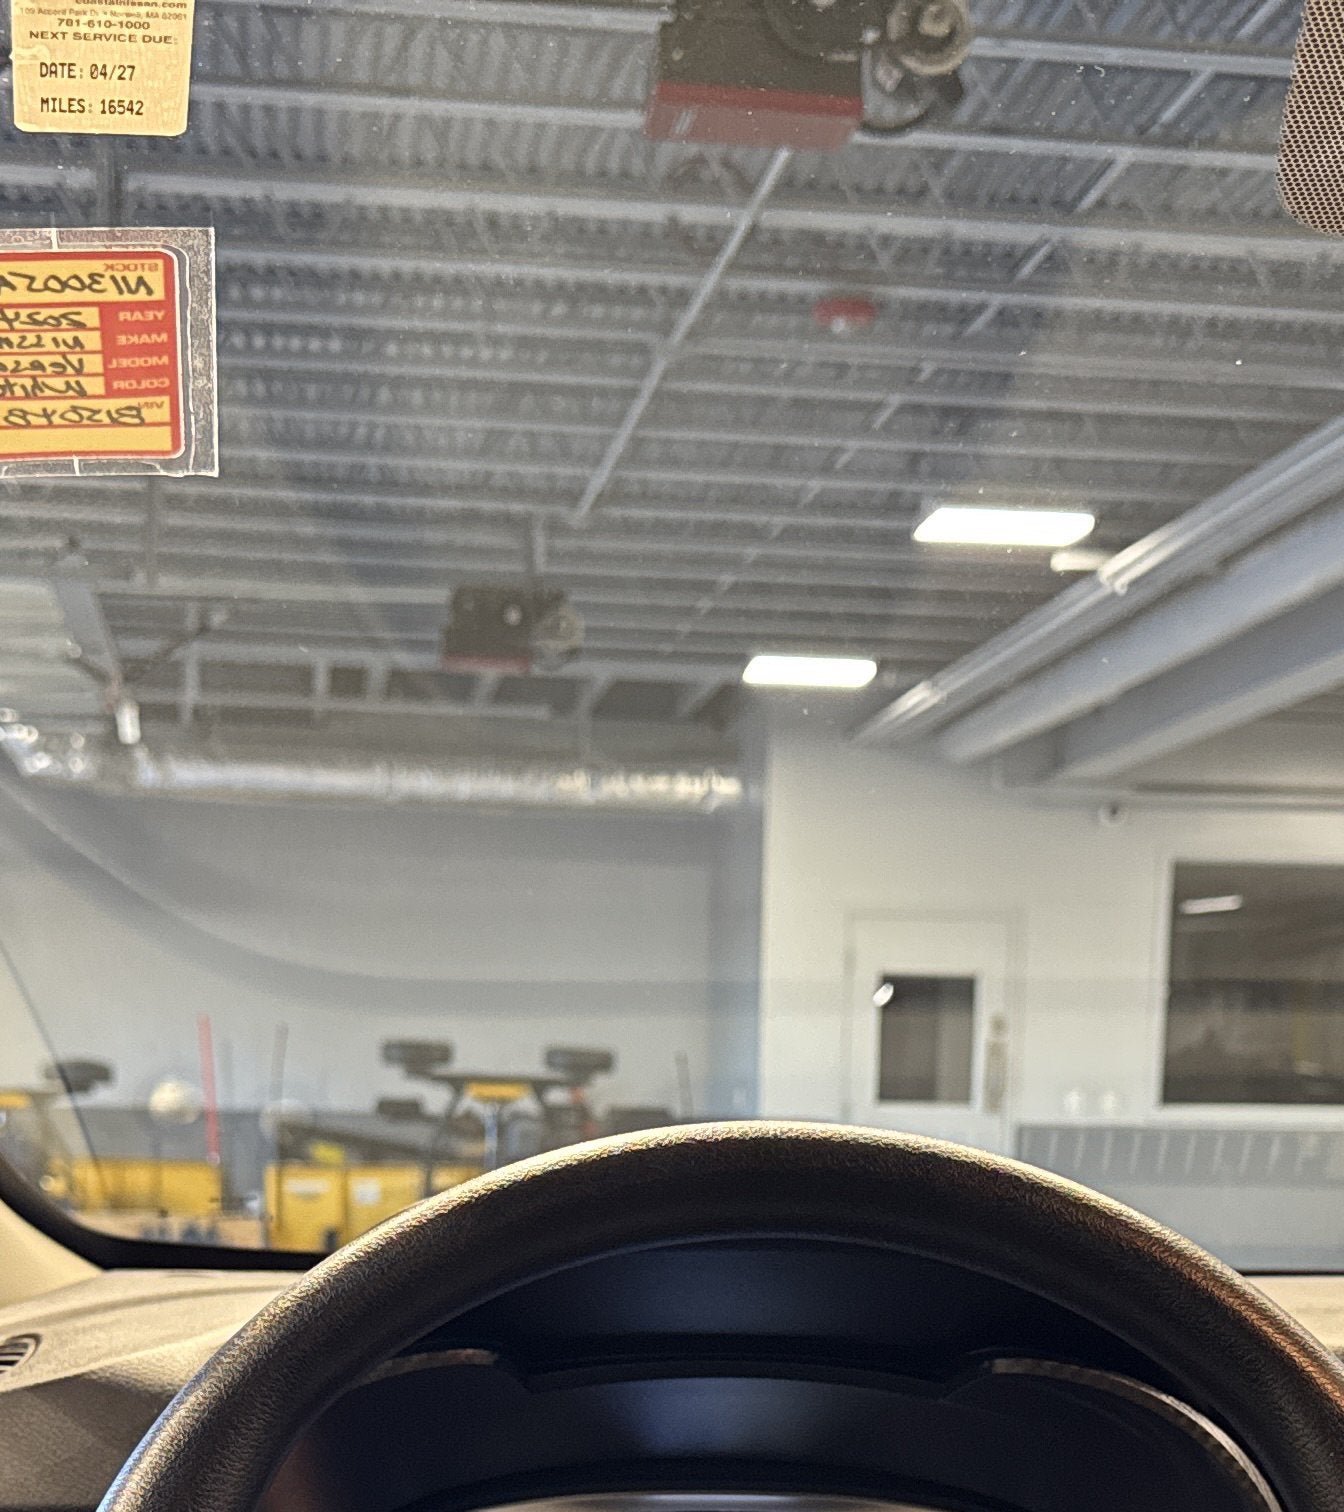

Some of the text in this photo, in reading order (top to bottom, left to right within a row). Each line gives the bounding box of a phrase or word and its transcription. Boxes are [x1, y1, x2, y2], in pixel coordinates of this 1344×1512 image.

[57, 18, 151, 30] 781-610-1000
[29, 31, 179, 45] NEXT SERVICE DUE:
[39, 62, 136, 82] DATE: 04/27
[40, 96, 144, 116] MILES: 16542
